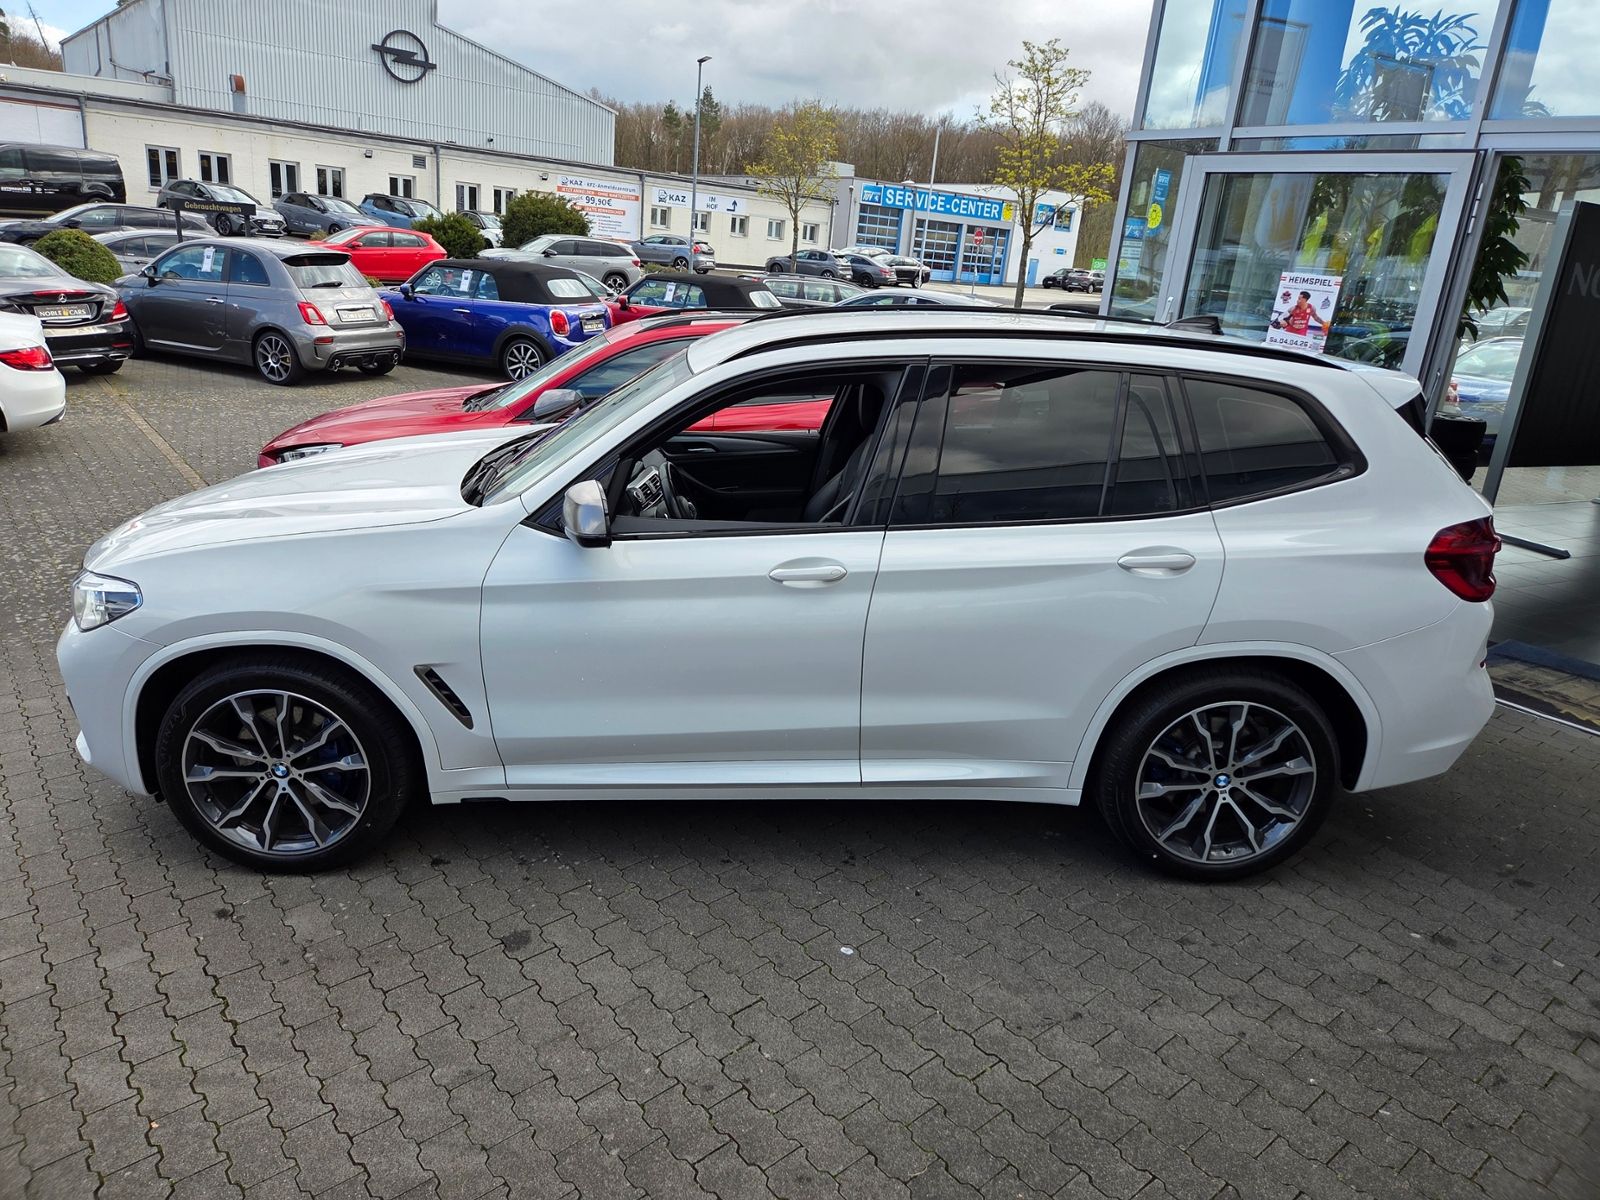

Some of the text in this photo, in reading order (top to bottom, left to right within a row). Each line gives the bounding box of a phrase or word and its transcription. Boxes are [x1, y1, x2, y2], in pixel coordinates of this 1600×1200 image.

[585, 195, 613, 207] 99,90€
[668, 193, 687, 203] KAZ
[886, 189, 999, 218] SERVICE-CENTER
[184, 201, 242, 213] Gebrauchtwagen
[1288, 276, 1332, 286] HEIMSPIEL
